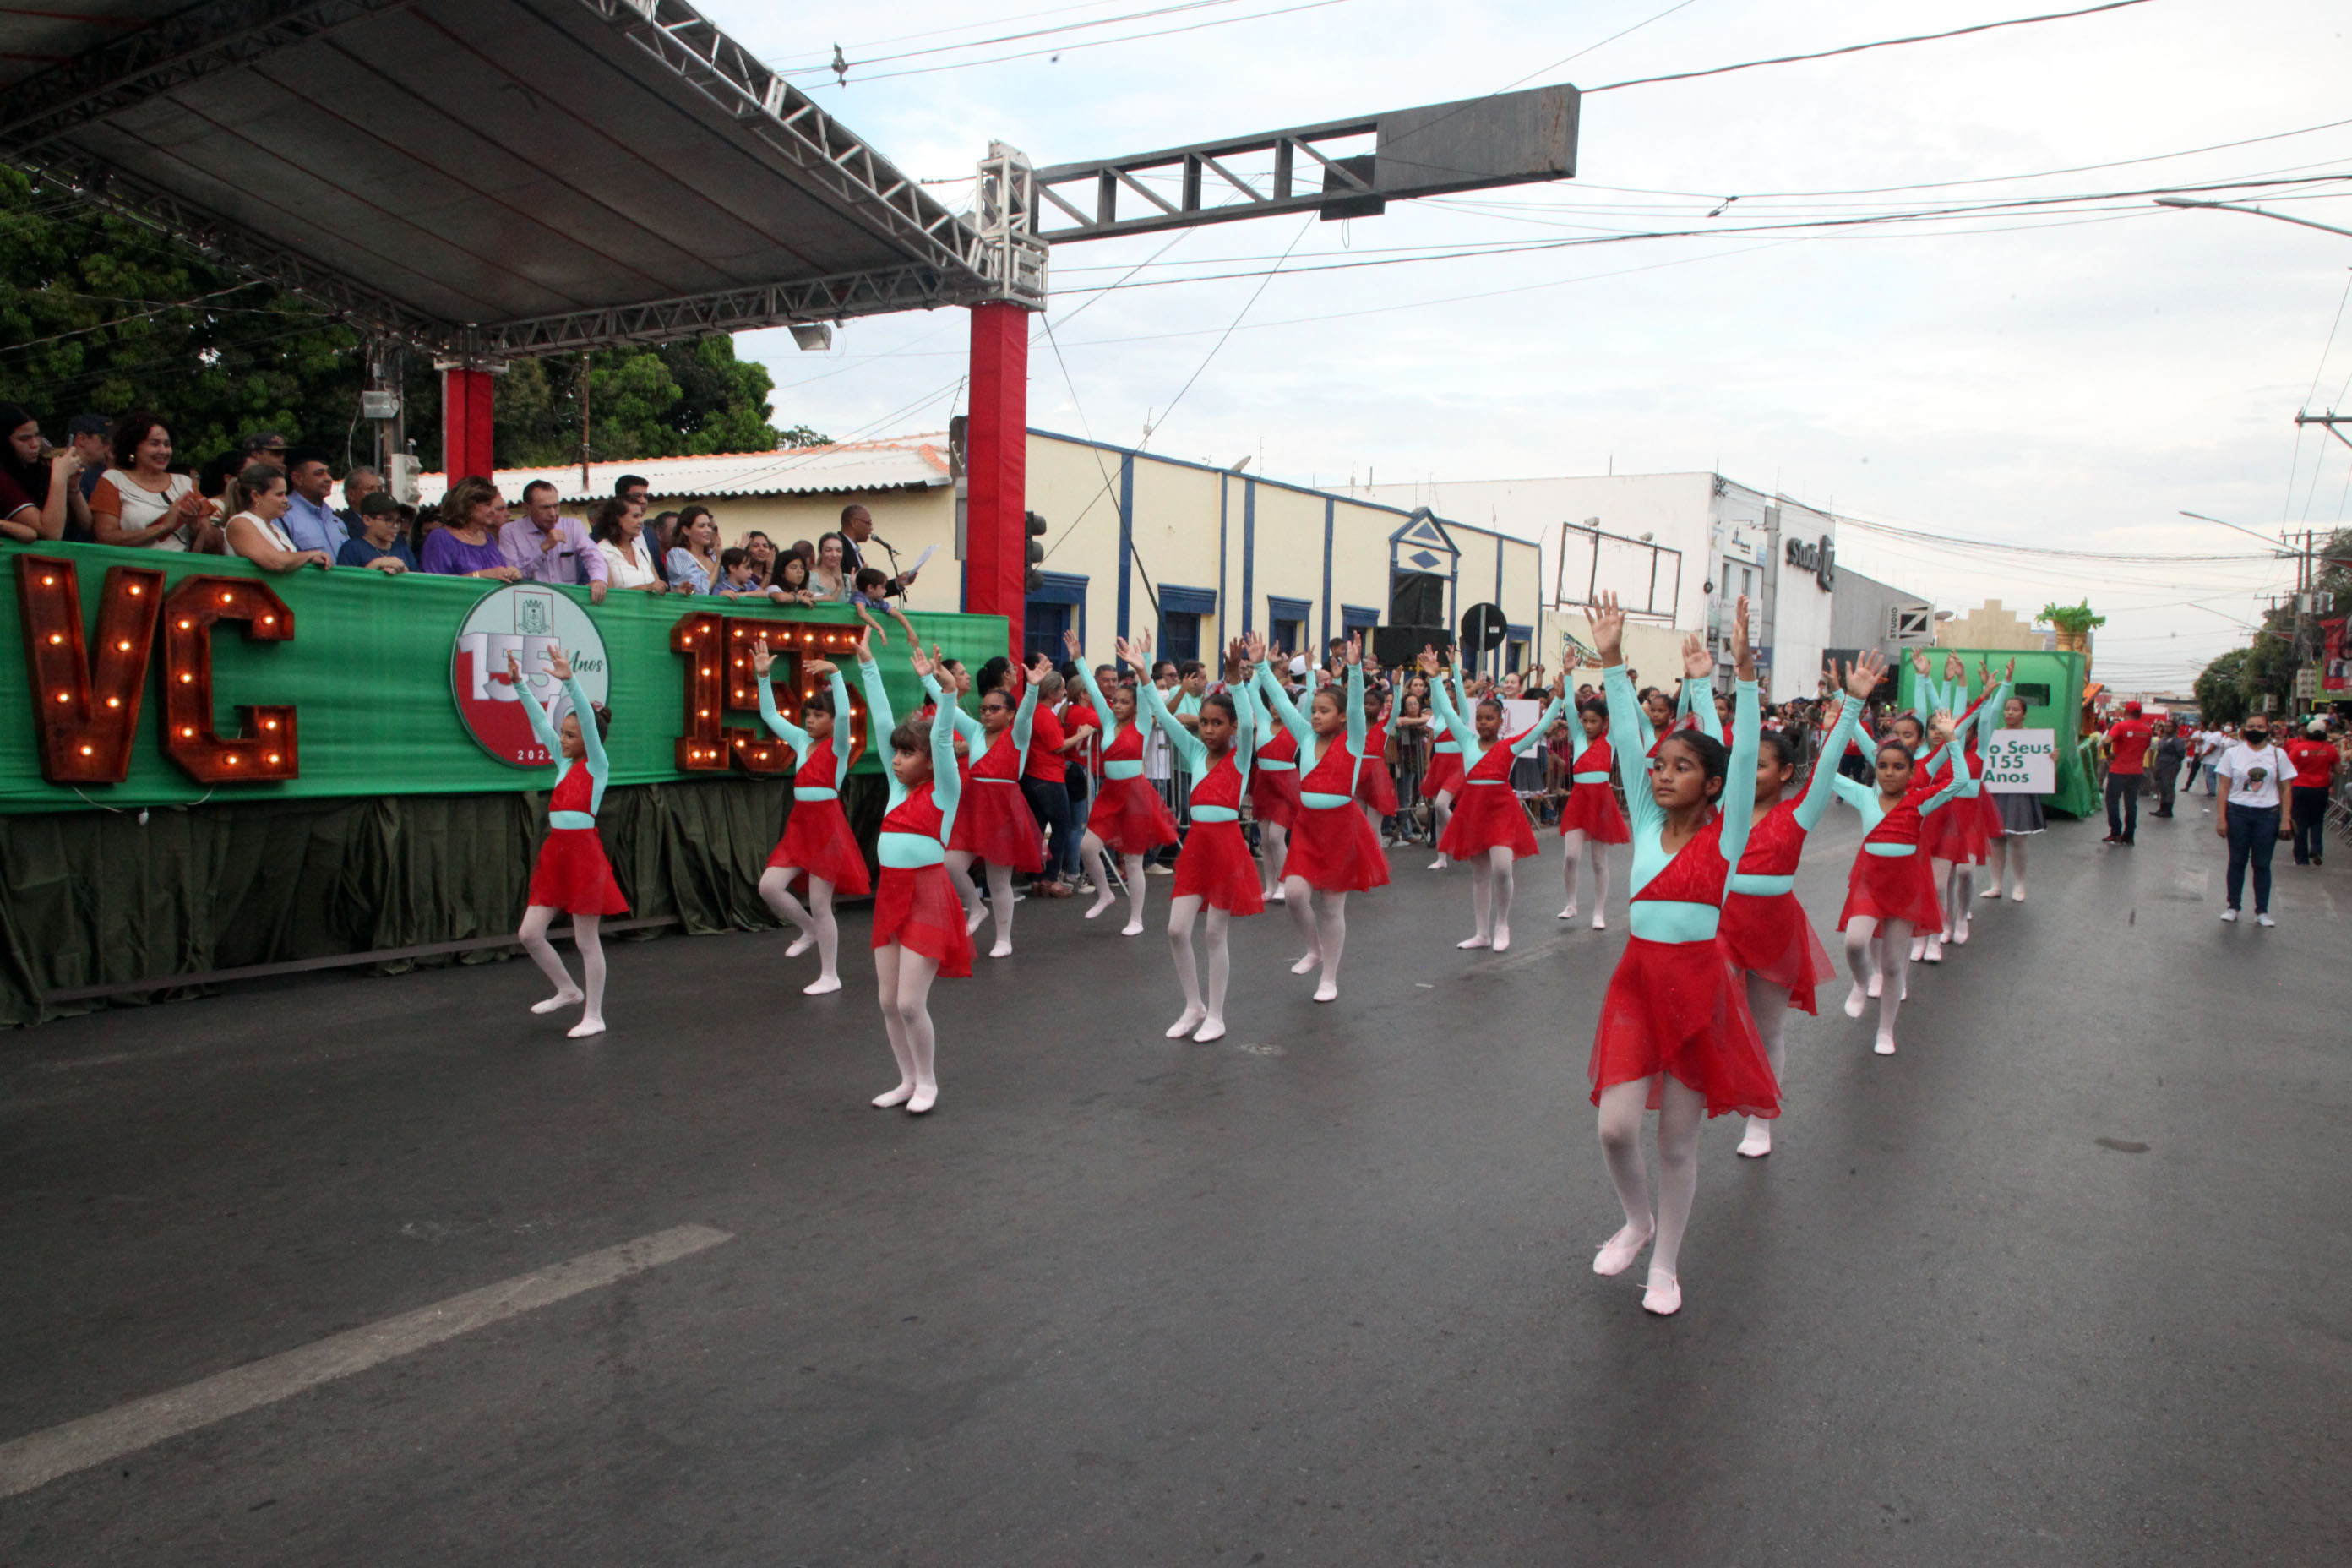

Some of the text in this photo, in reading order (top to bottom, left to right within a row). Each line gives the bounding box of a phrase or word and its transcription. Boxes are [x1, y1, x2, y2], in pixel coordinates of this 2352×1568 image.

[458, 632, 564, 702] 155
[568, 650, 603, 672] Anos
[670, 611, 868, 772] 155
[2008, 740, 2051, 754] Seus
[1990, 755, 2024, 769] 155
[1983, 770, 2029, 783] Anos
